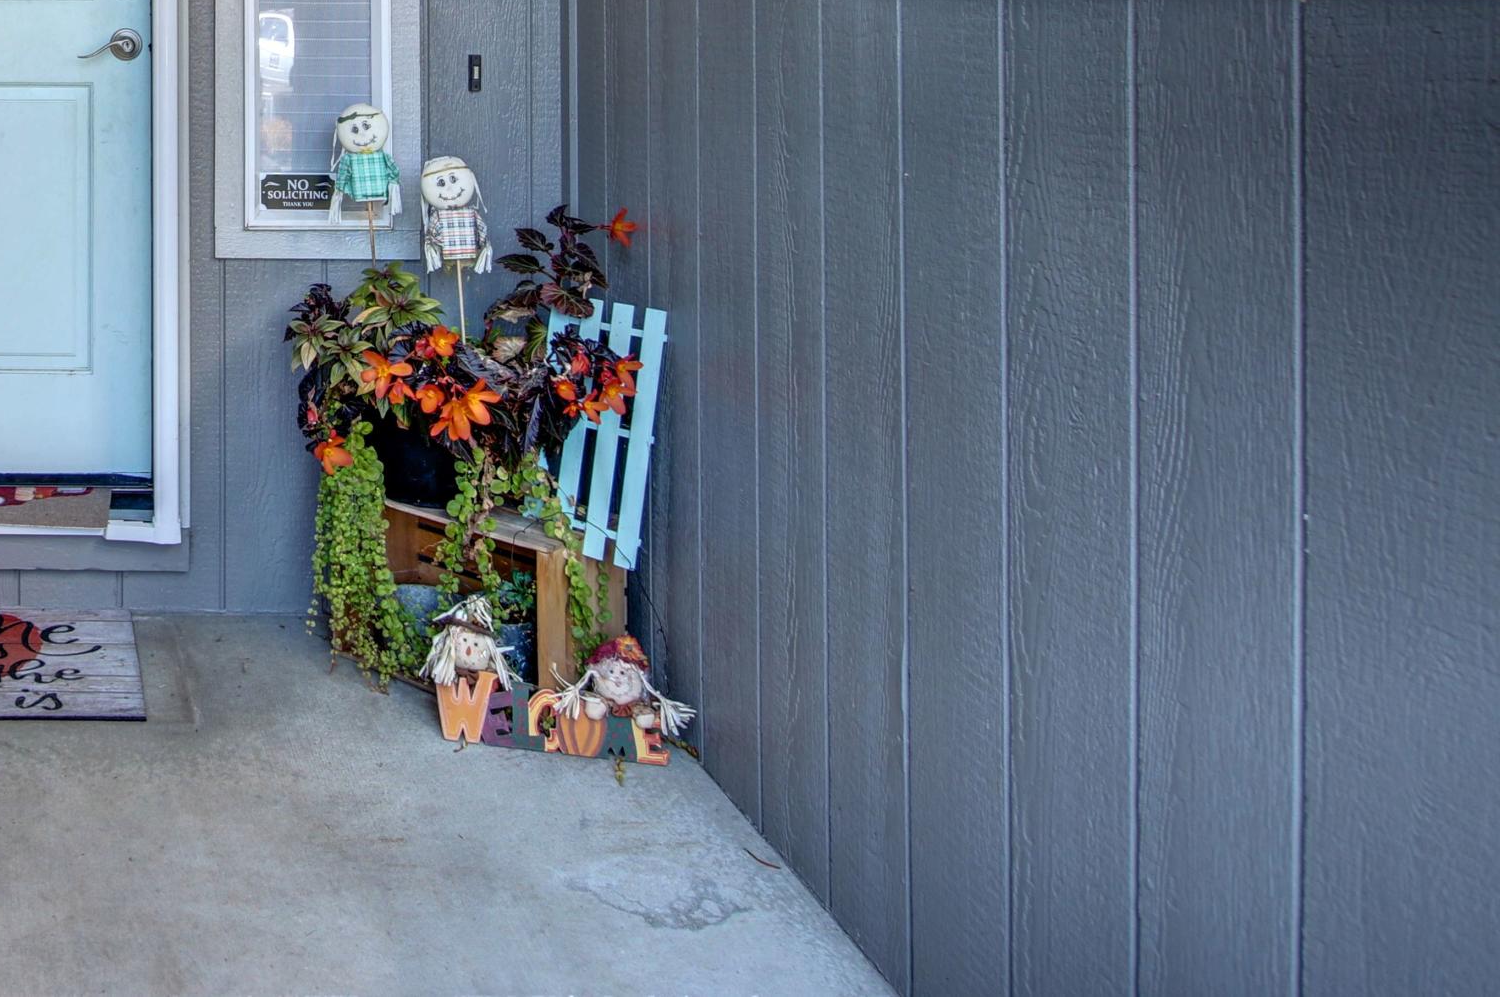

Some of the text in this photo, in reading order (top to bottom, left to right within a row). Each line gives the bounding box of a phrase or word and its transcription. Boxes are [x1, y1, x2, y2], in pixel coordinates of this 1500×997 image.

[287, 179, 309, 191] NO
[267, 190, 329, 200] SOLICITING
[14, 689, 64, 712] is
